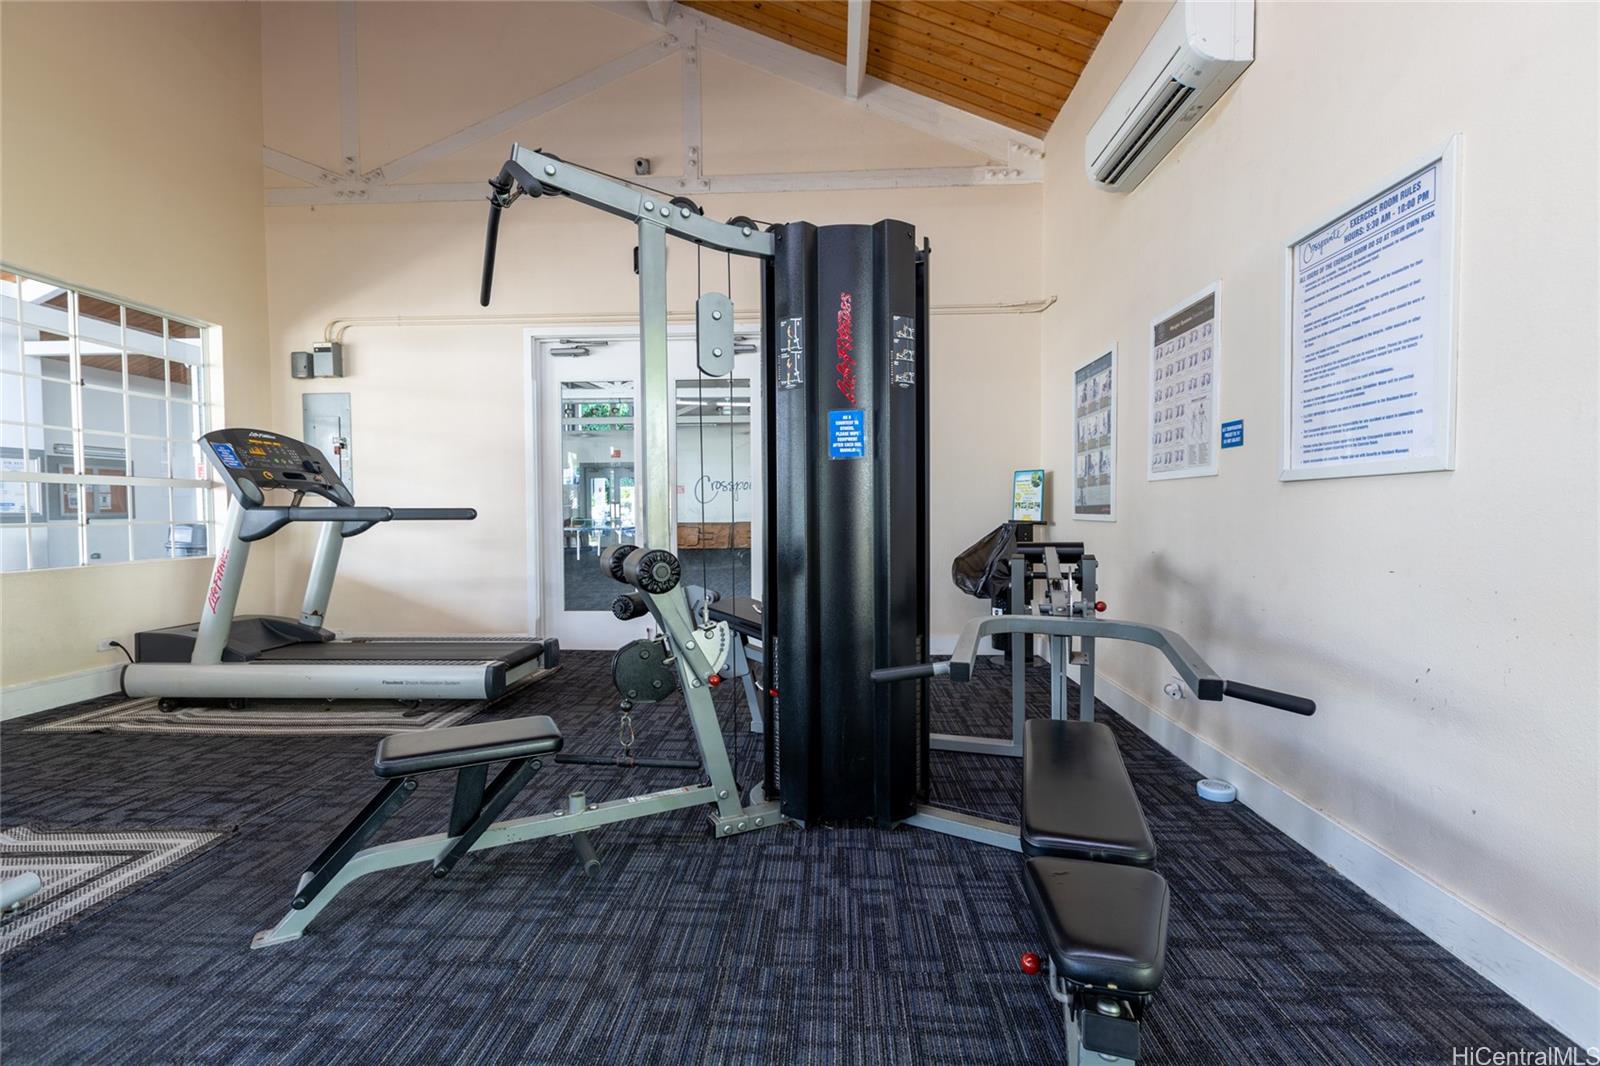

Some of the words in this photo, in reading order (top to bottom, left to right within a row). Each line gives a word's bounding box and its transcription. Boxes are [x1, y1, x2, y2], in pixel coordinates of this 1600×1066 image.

[1350, 206, 1378, 229] EXERCISE
[1379, 194, 1399, 213] ROOM
[1400, 181, 1421, 200] RULES
[1366, 217, 1379, 232] 5:30
[1380, 212, 1391, 225] AM
[1398, 200, 1415, 216] 10:00
[1417, 190, 1430, 205] PM
[1353, 243, 1367, 257] ROOM
[1383, 231, 1390, 242] AT
[1390, 223, 1404, 239] THEIR
[1405, 216, 1419, 231] OWN
[1420, 208, 1435, 224] RISK
